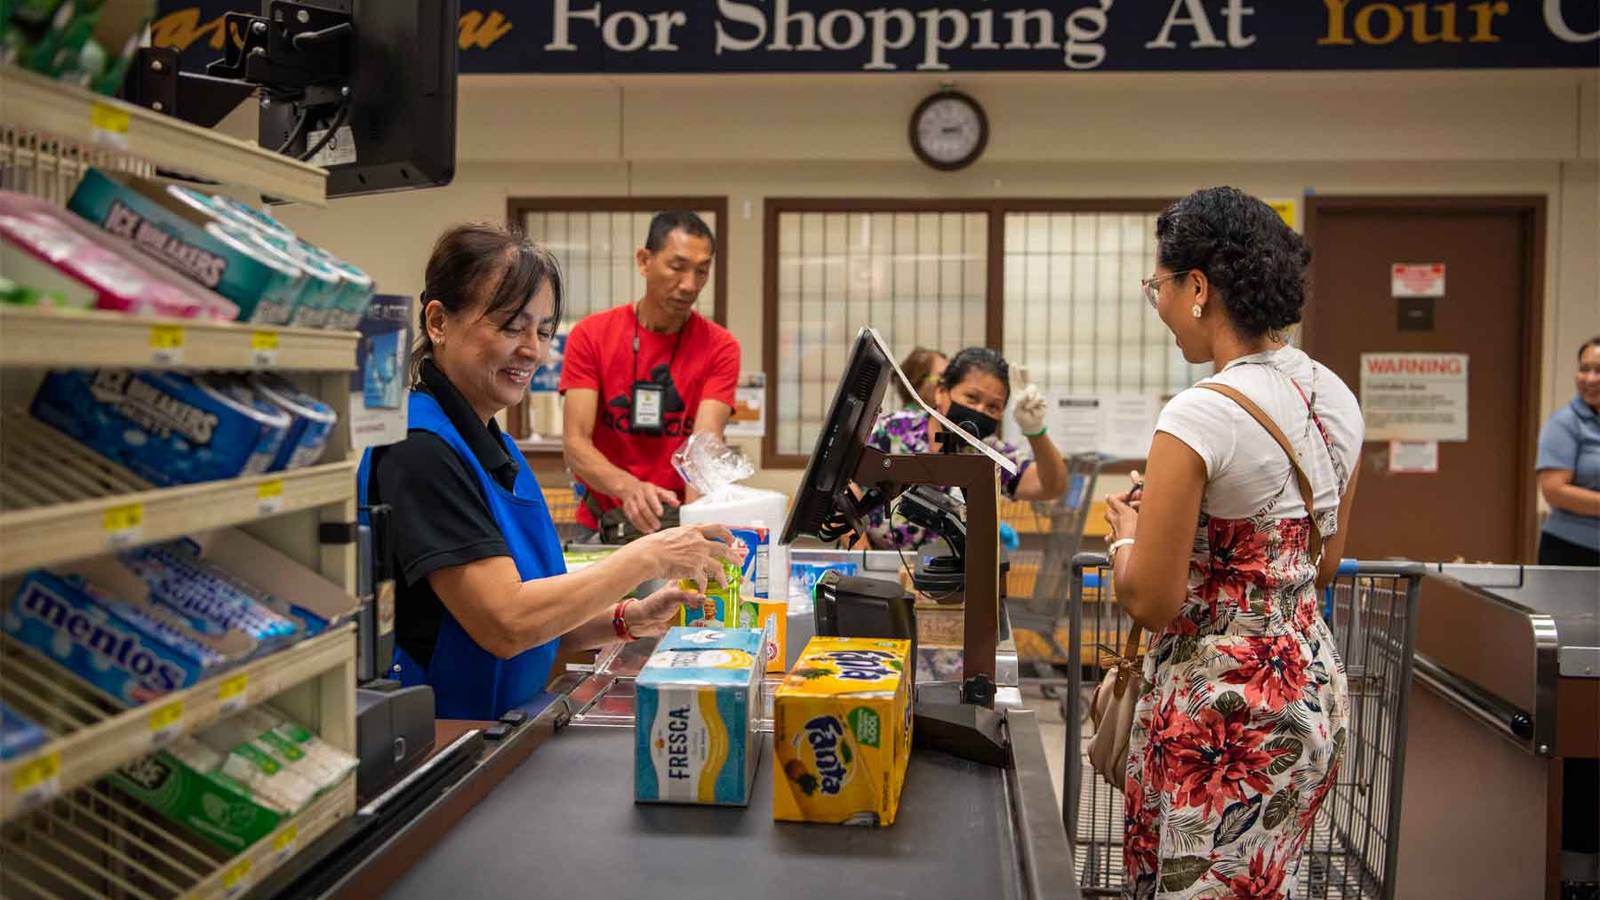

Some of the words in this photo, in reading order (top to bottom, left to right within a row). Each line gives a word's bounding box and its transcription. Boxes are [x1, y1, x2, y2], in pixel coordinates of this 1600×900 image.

[544, 0, 686, 52] For
[715, 0, 1108, 70] Shopping
[1145, 0, 1256, 49] At
[1317, 0, 1508, 46] Your
[1367, 358, 1461, 376] WARNING
[603, 410, 695, 435] adas
[24, 586, 177, 692] mentos
[668, 704, 691, 780] FRESCA
[805, 715, 847, 795] Fanta
